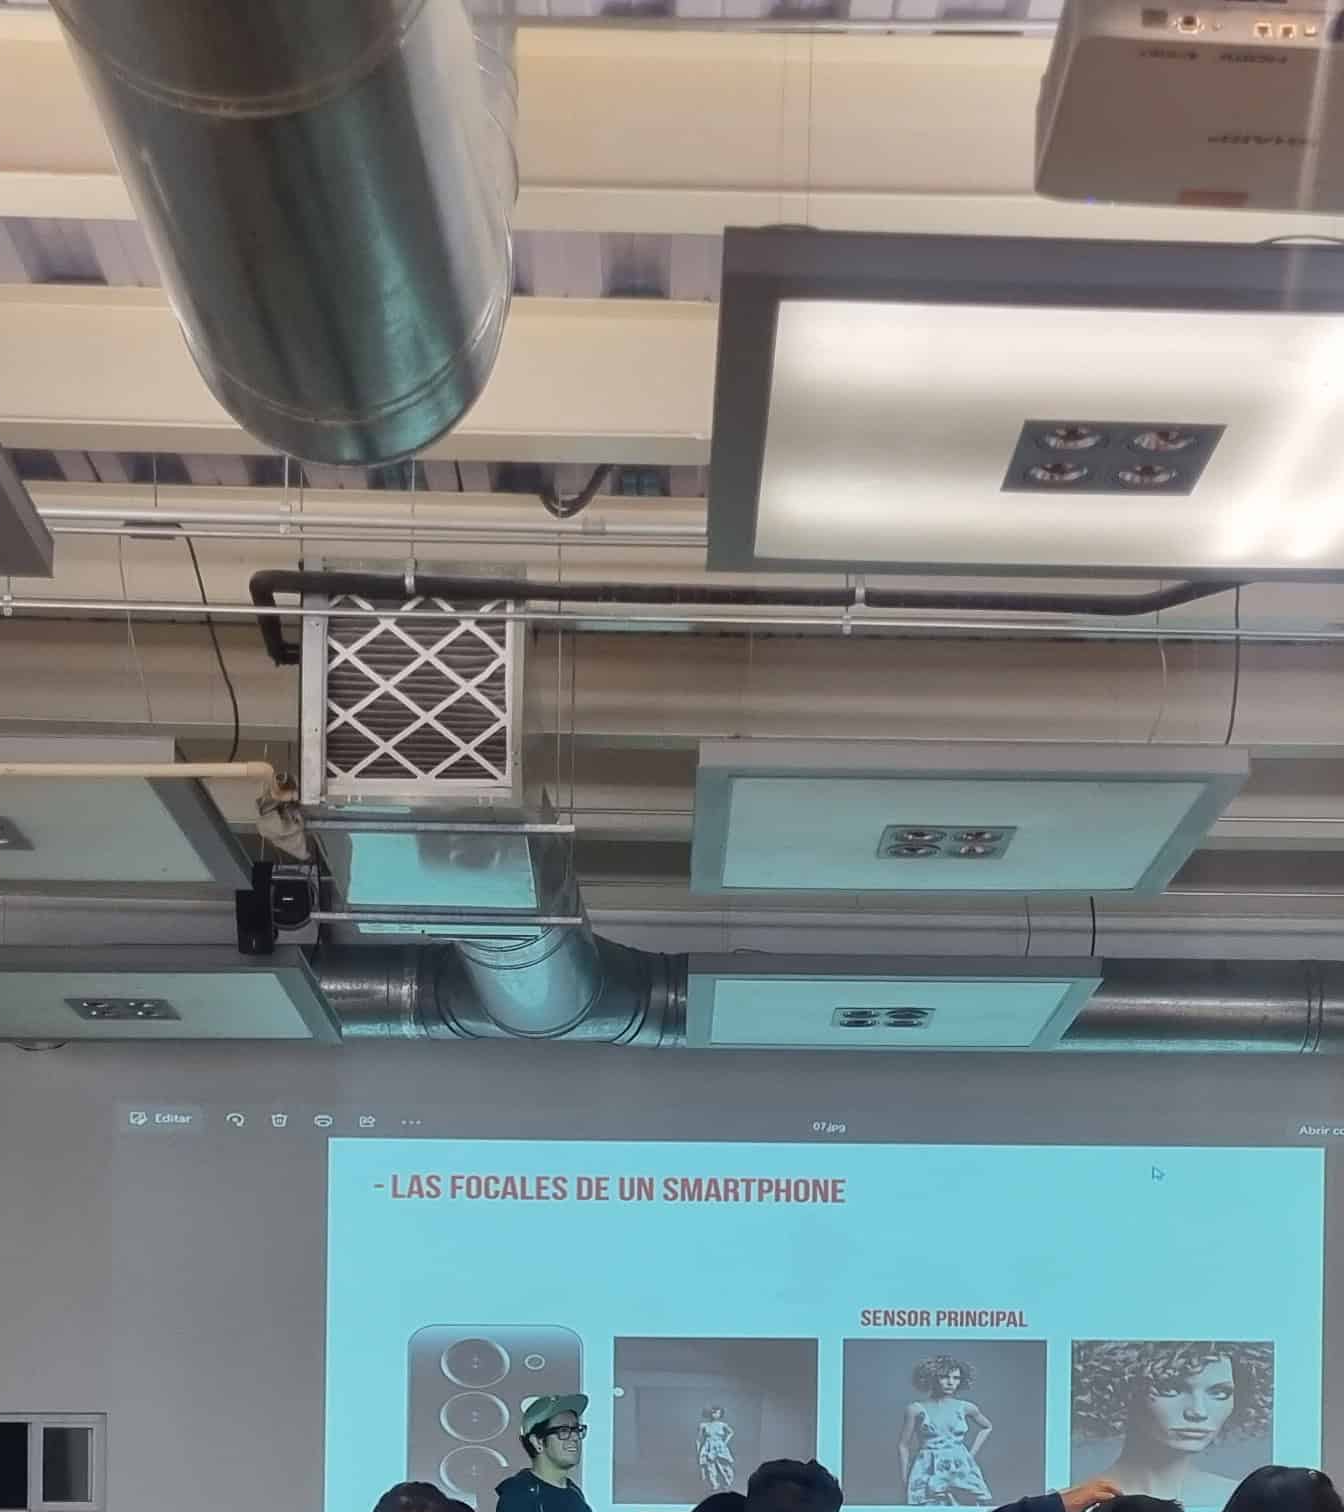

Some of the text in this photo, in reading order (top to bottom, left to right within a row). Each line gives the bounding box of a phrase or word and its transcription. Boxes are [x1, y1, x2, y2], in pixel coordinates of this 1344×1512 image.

[155, 1112, 192, 1124] Editar
[1298, 1125, 1329, 1136] Abrir
[391, 1174, 441, 1199] LAS
[450, 1175, 568, 1201] FOCALES
[576, 1176, 610, 1201] DE
[619, 1177, 654, 1201] UN
[663, 1177, 846, 1203] SMARTPHONE
[860, 1309, 1029, 1328] SENSOR PRINCIPAL
